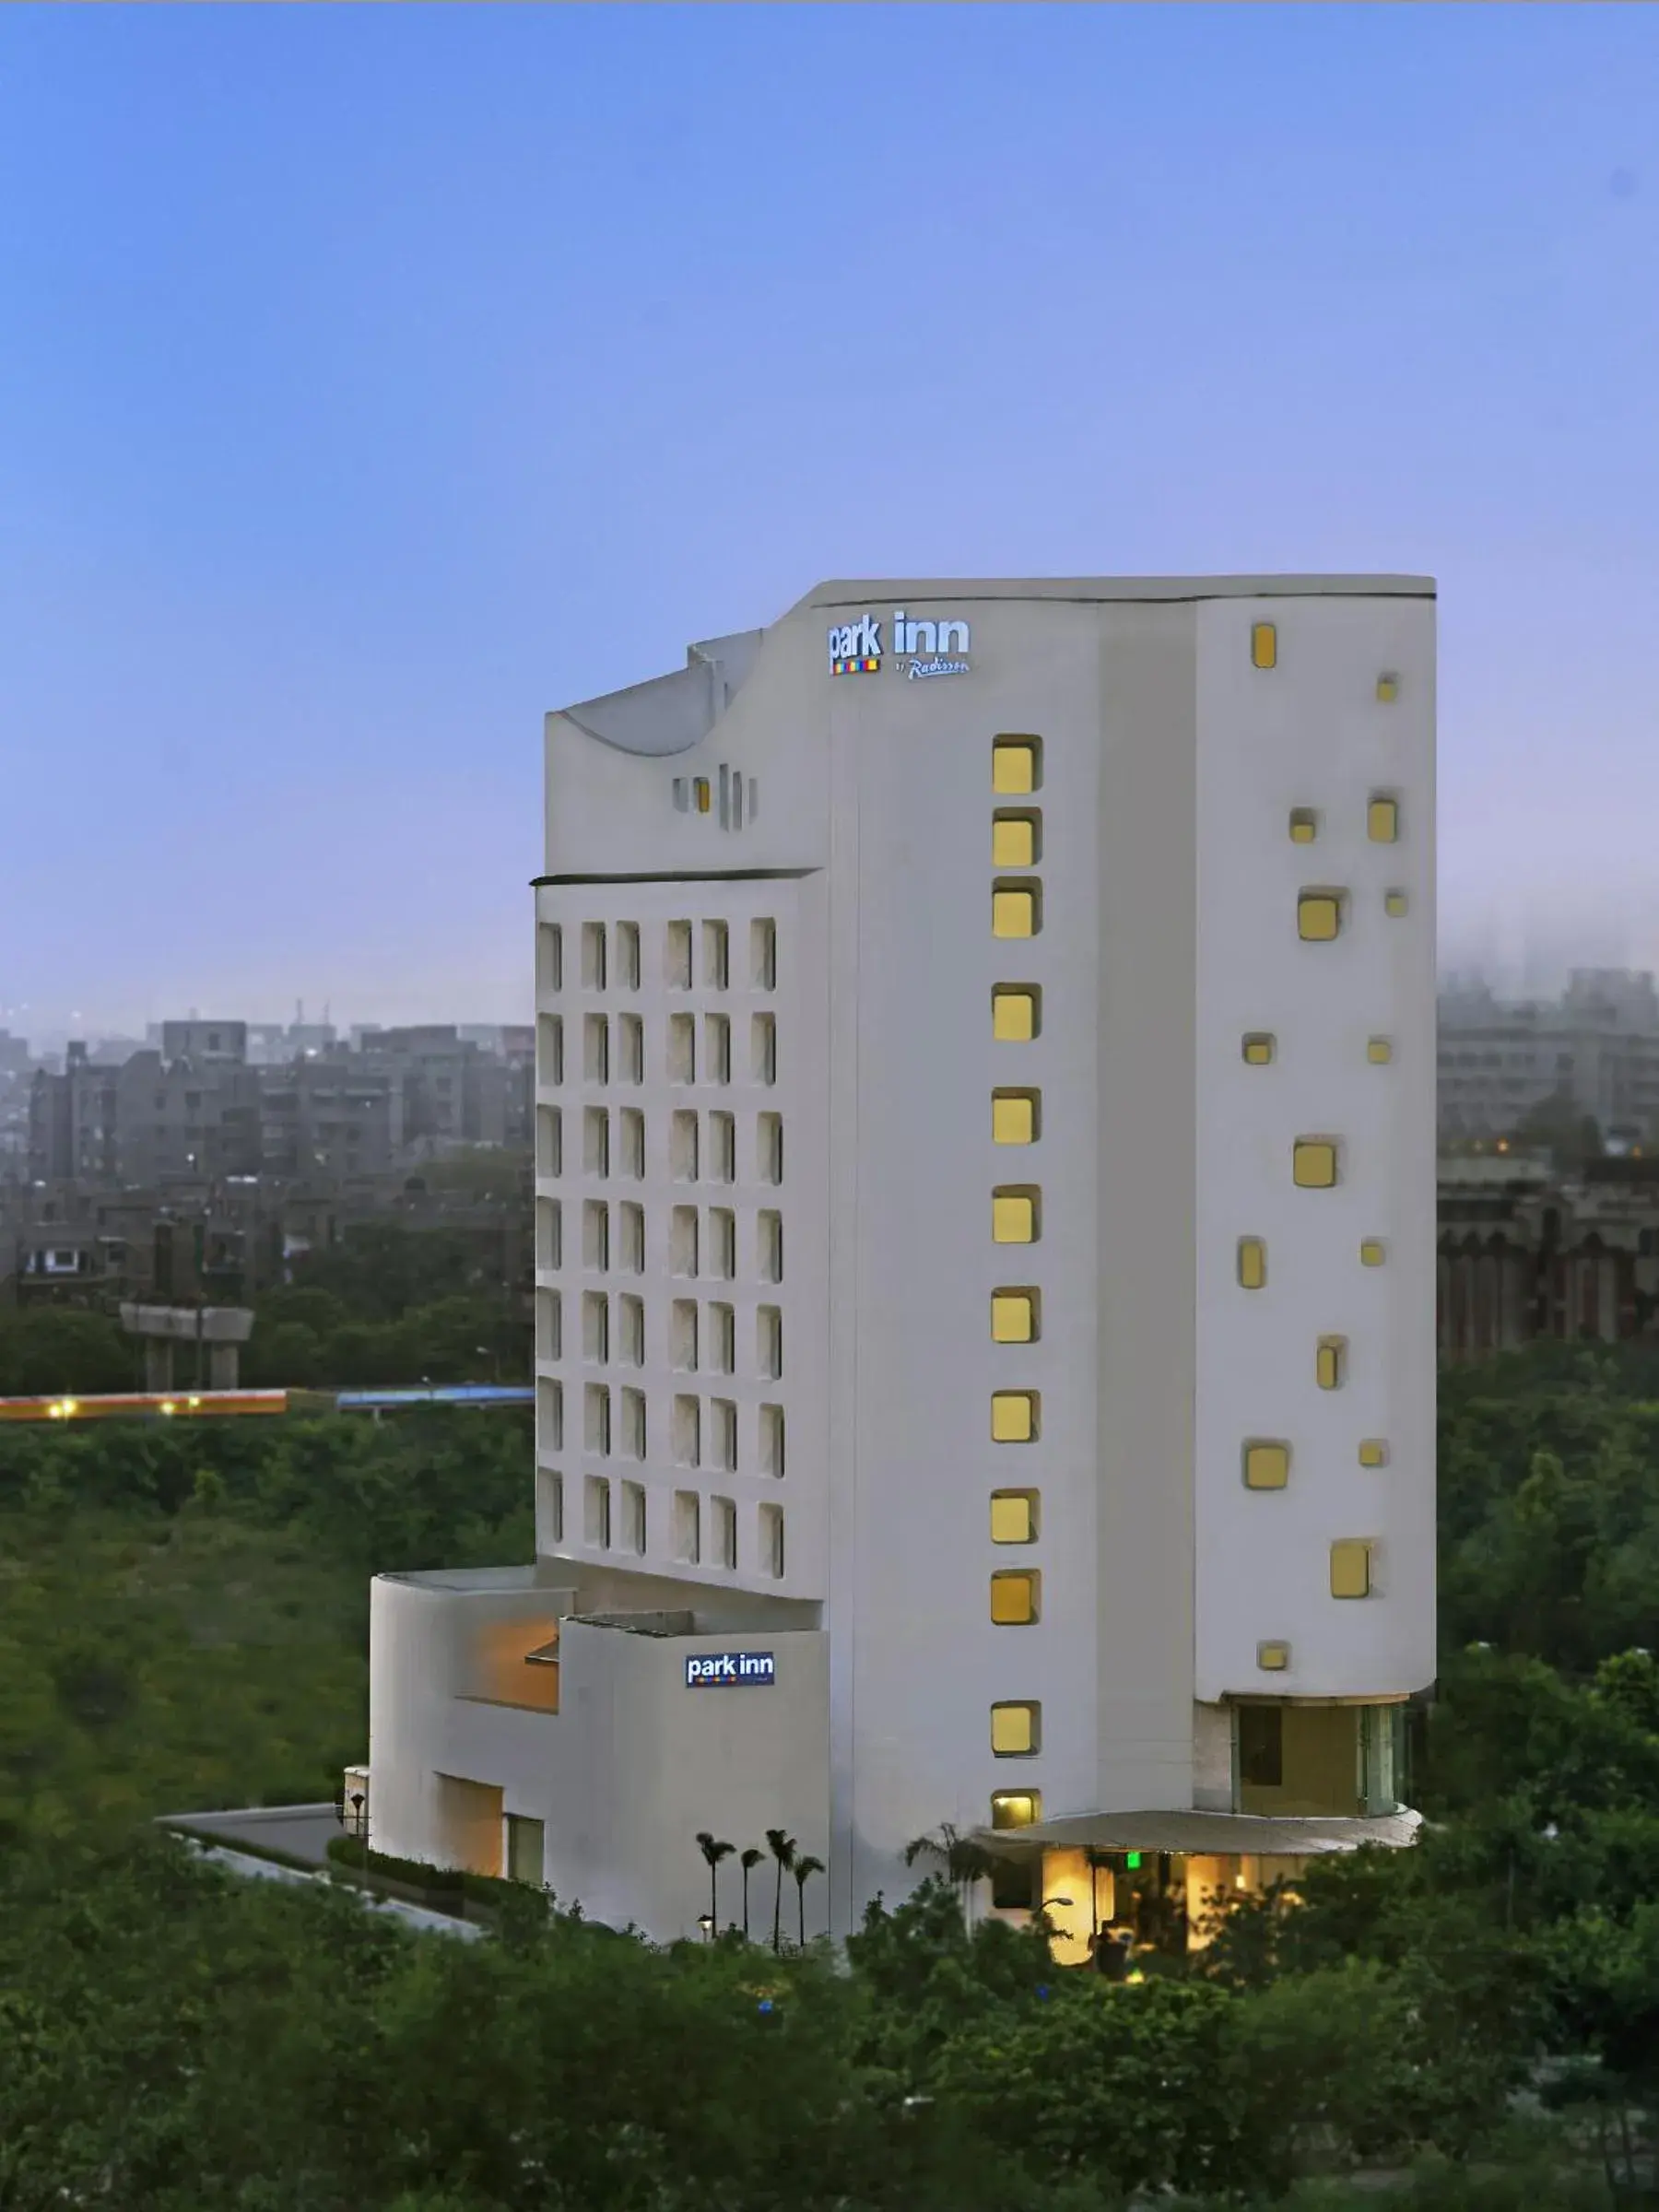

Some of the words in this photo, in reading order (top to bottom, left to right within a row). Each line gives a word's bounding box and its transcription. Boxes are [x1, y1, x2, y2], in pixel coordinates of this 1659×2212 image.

[830, 613, 881, 675] park
[894, 611, 969, 653] inn
[908, 656, 970, 679] Radisson
[688, 1655, 736, 1683] park
[740, 1654, 773, 1674] inn
